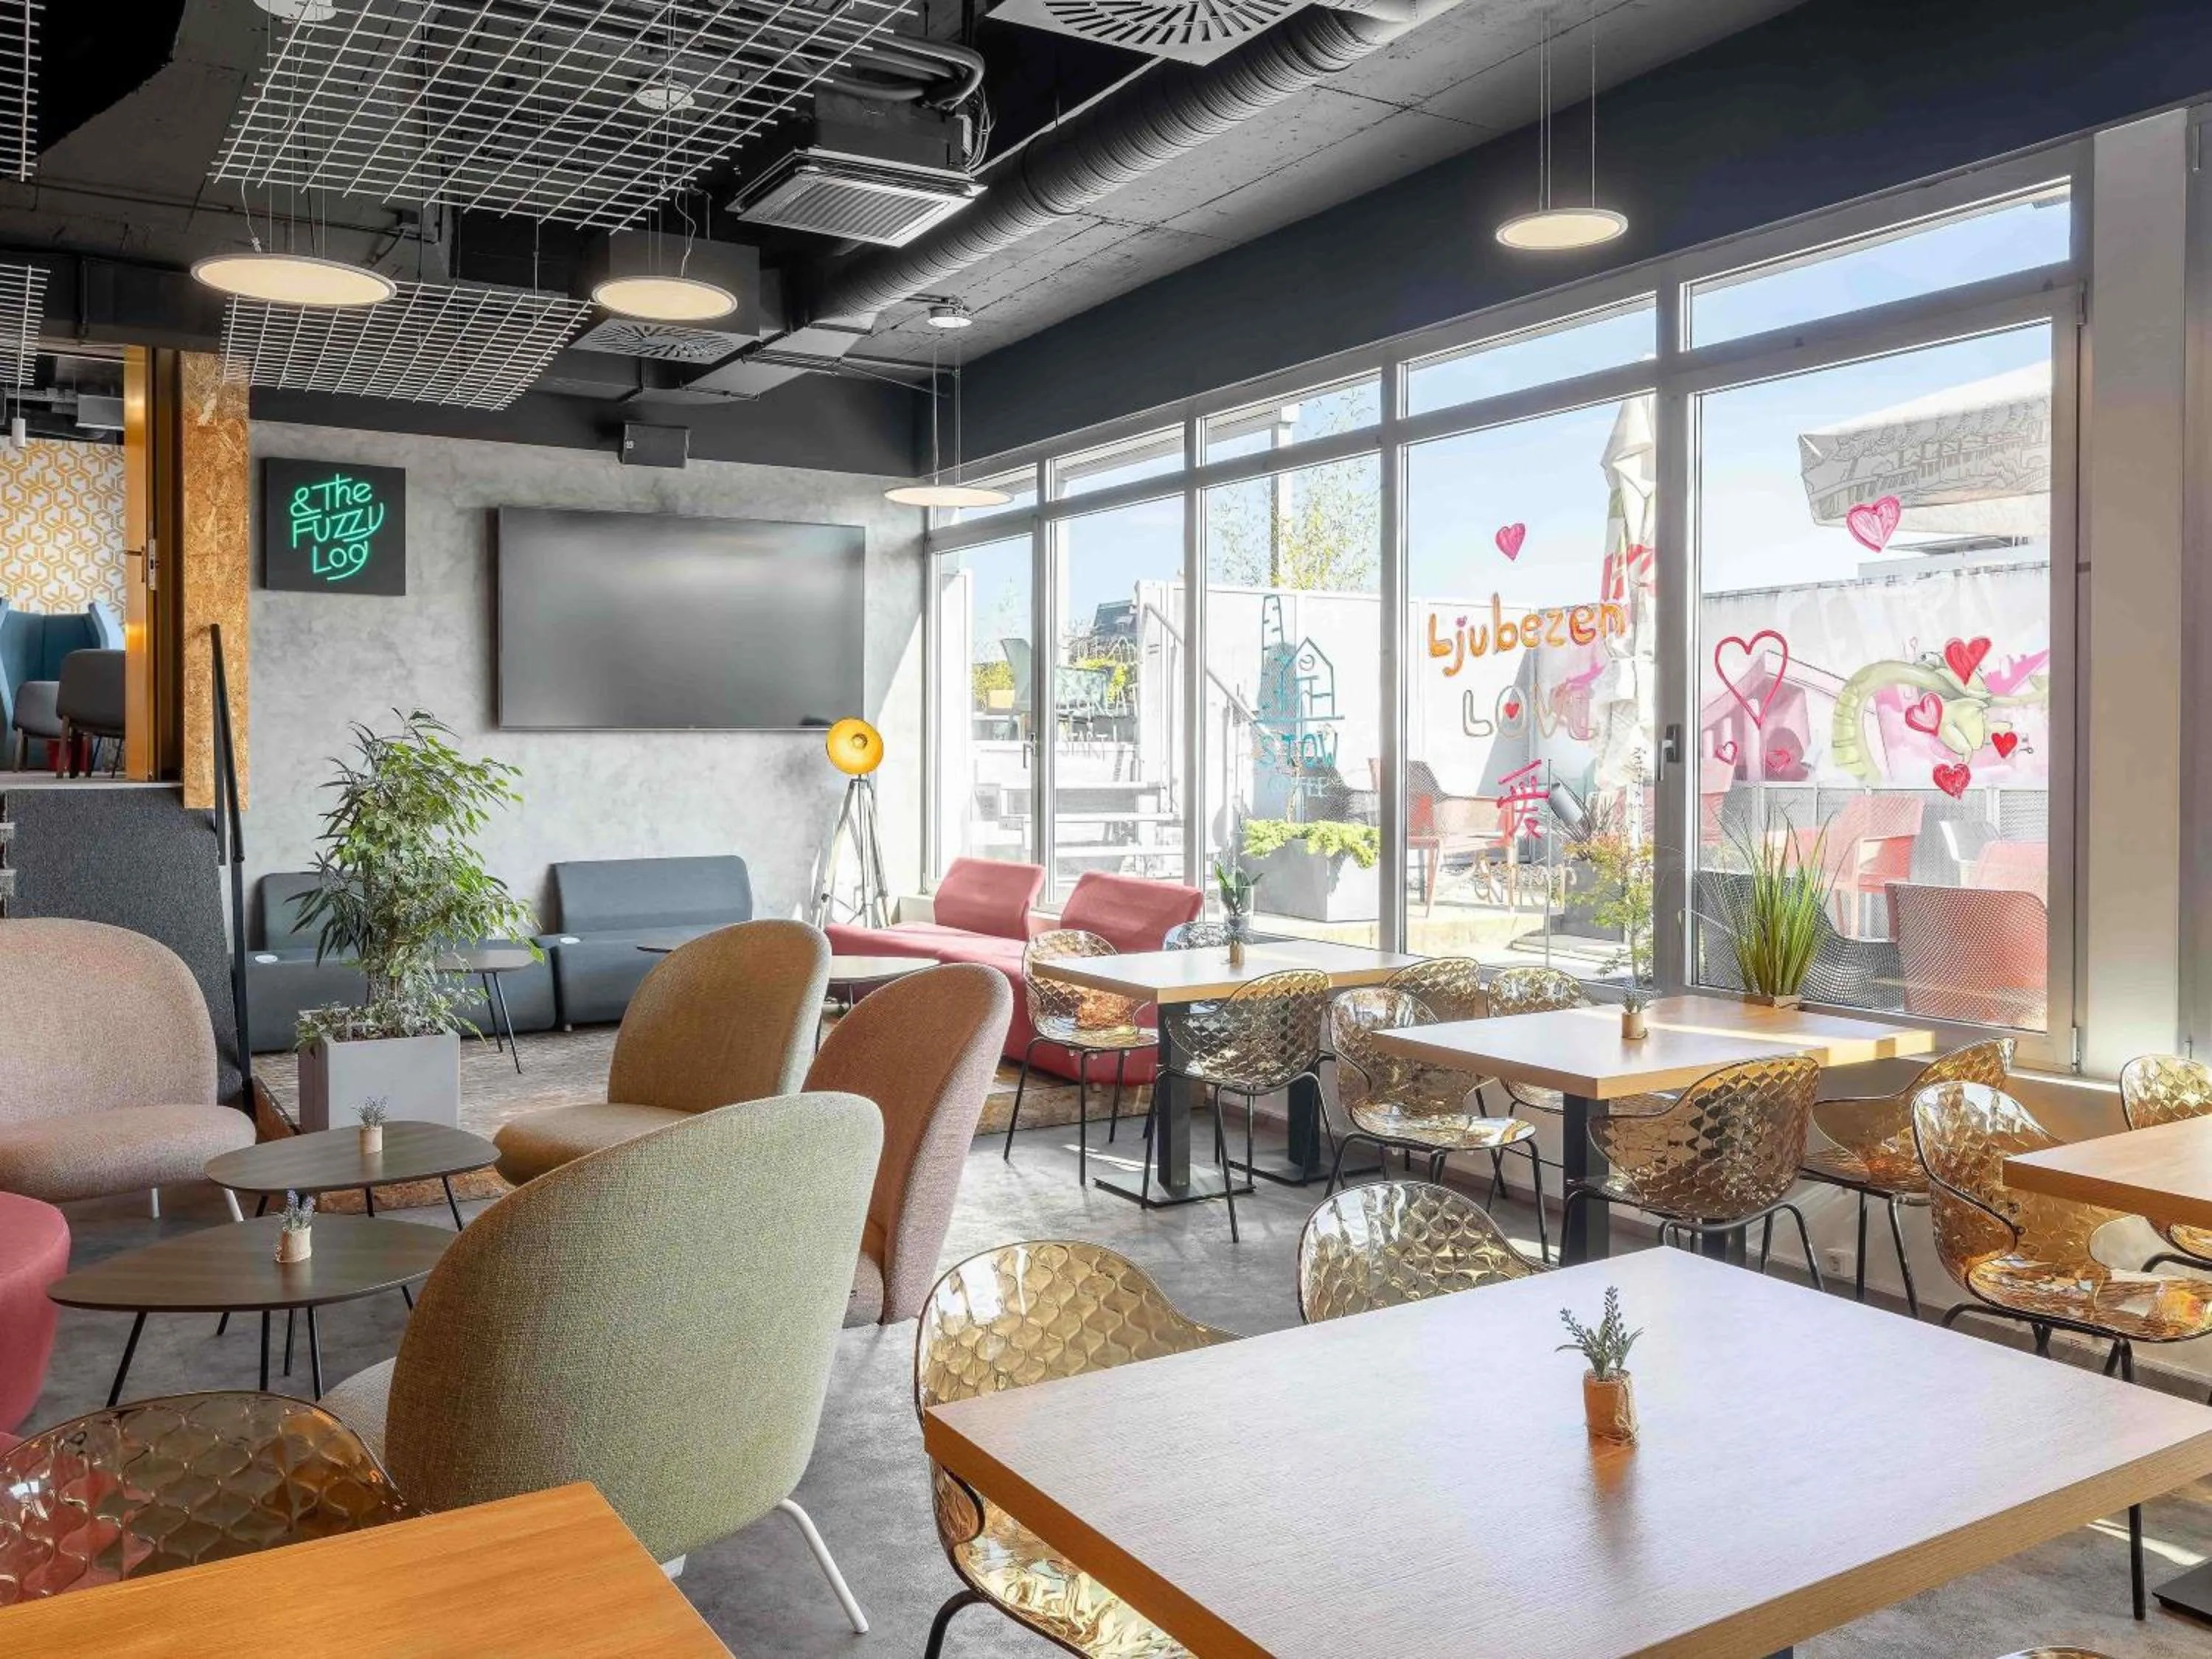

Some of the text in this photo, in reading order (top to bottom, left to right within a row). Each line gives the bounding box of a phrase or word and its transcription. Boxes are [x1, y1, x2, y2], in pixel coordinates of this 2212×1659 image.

[291, 473, 373, 517] & The
[1427, 591, 1626, 676] Ljubezen
